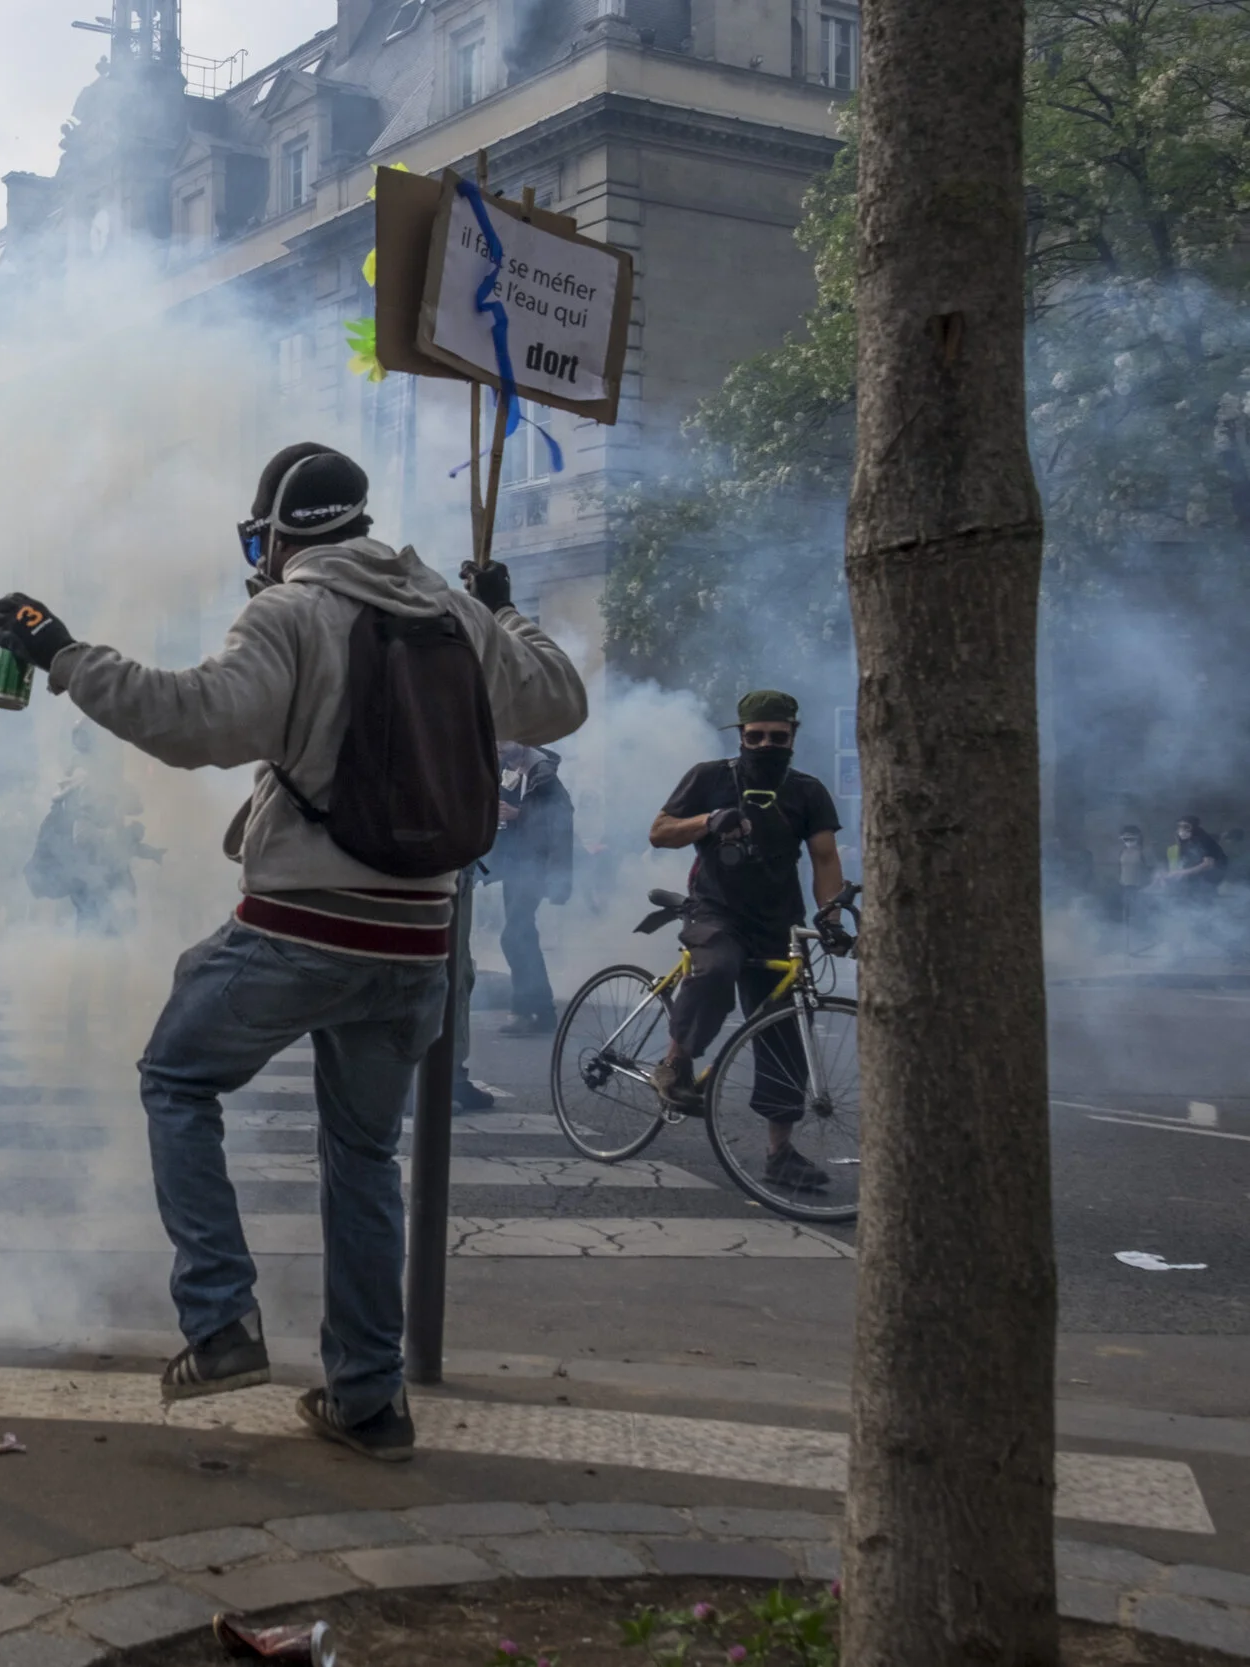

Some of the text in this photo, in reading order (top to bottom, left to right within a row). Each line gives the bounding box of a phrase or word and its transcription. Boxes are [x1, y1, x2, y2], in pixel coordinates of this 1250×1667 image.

[461, 226, 472, 249] il
[508, 258, 528, 279] se
[533, 268, 597, 301] méfier
[506, 281, 549, 317] l'eau
[554, 305, 588, 328] qui
[526, 342, 579, 383] dort
[16, 606, 43, 627] 3
